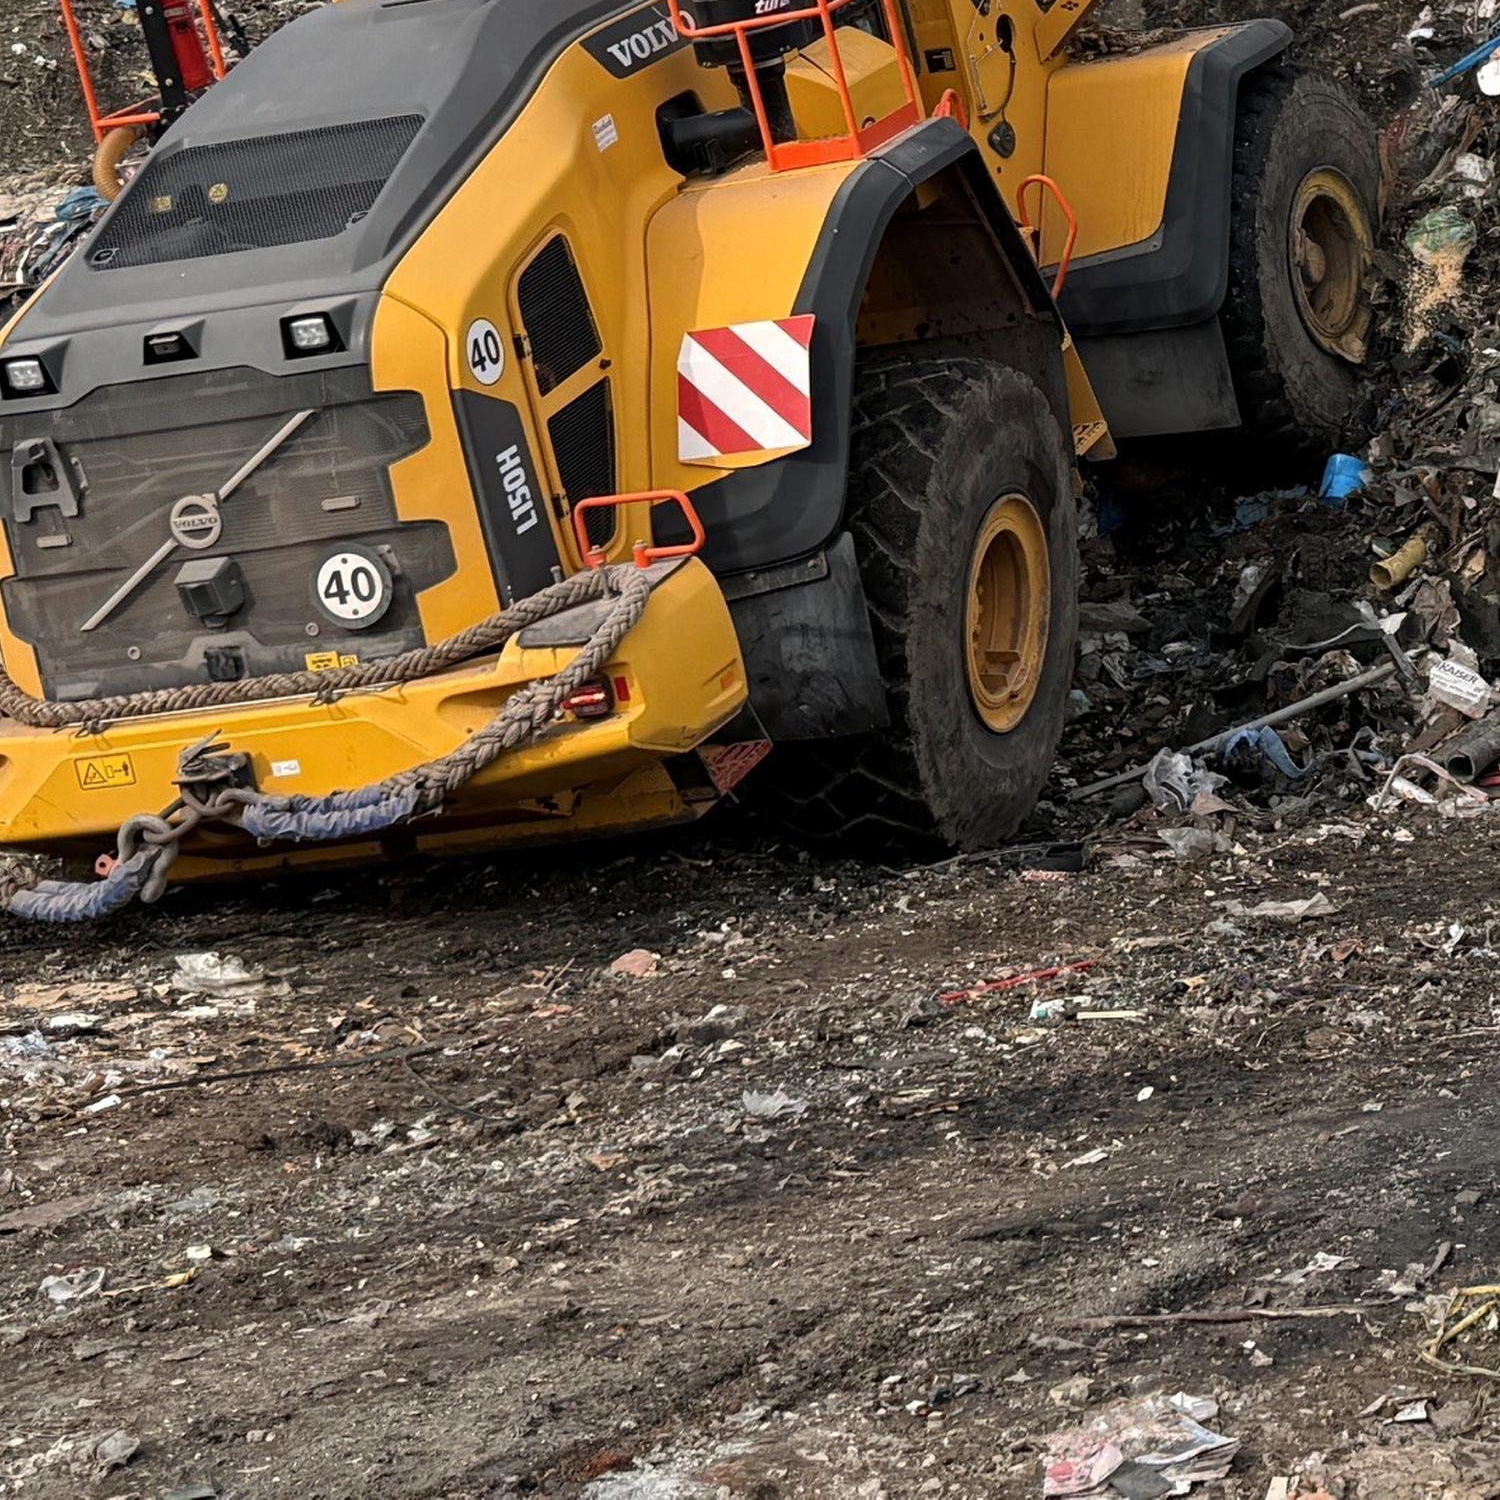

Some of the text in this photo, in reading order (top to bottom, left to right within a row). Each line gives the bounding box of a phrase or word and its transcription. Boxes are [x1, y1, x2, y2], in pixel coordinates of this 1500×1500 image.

[471, 329, 500, 372] 40
[496, 445, 538, 535] L150H
[324, 566, 376, 605] 40
